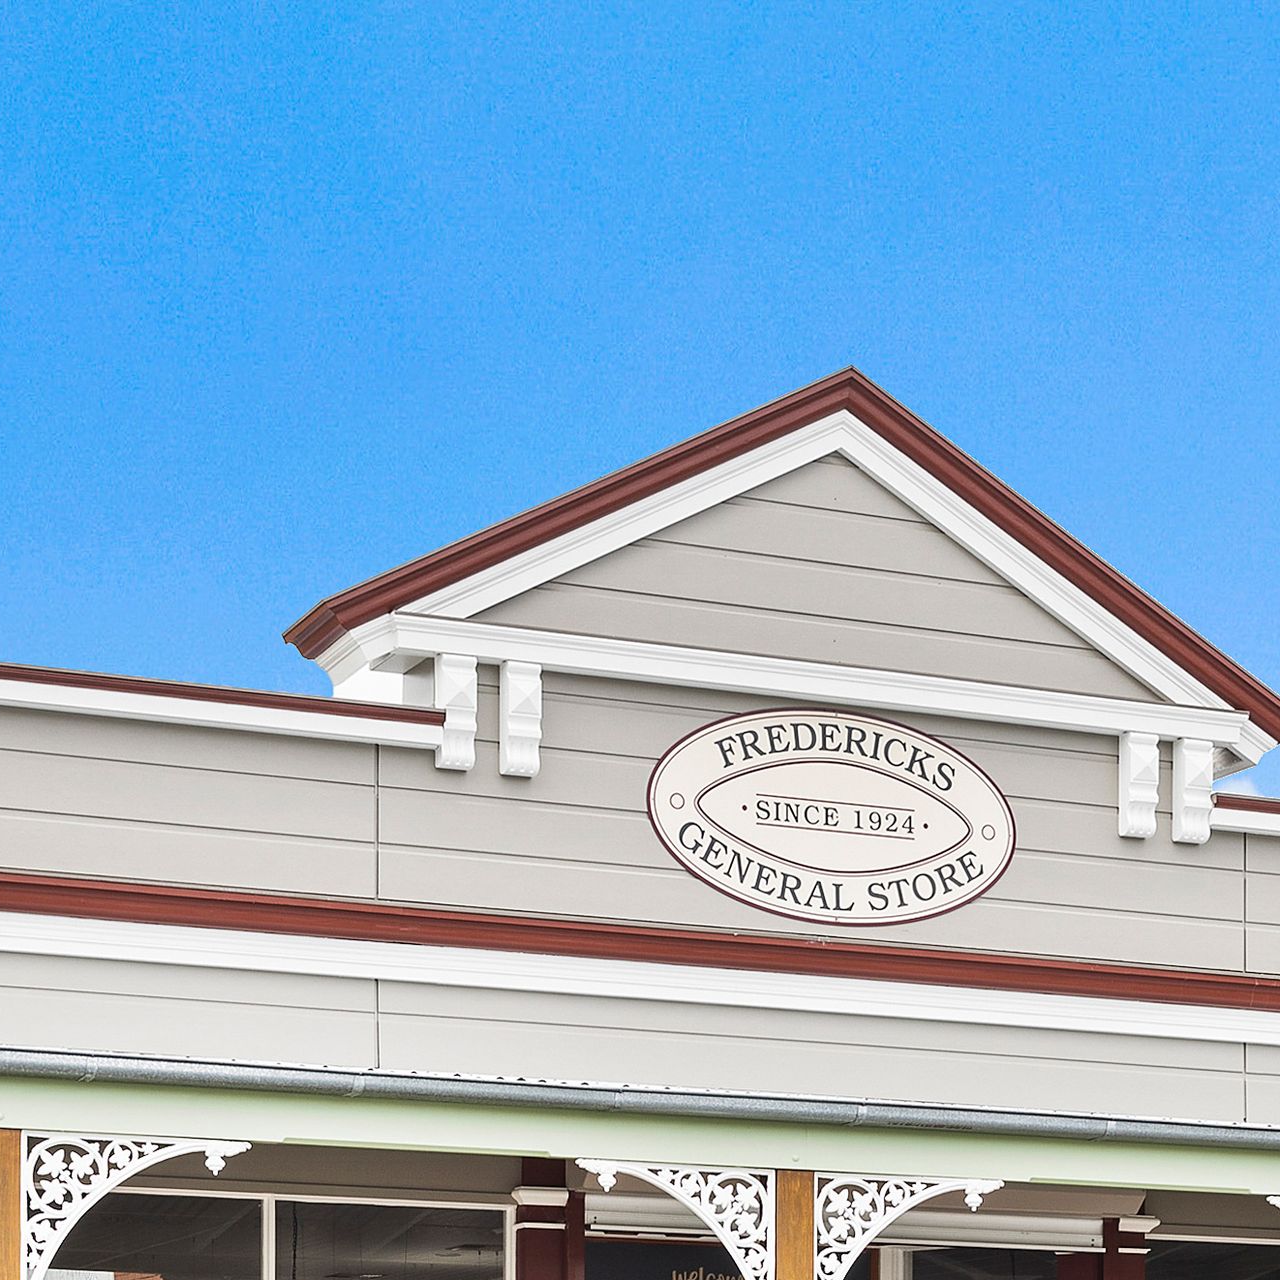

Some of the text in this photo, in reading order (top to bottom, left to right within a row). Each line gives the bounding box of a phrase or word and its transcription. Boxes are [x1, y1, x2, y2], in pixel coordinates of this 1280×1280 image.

[714, 723, 956, 792] FREDERICKS
[756, 800, 915, 834] SINCE 1924
[678, 822, 984, 911] GENERAL STORE
